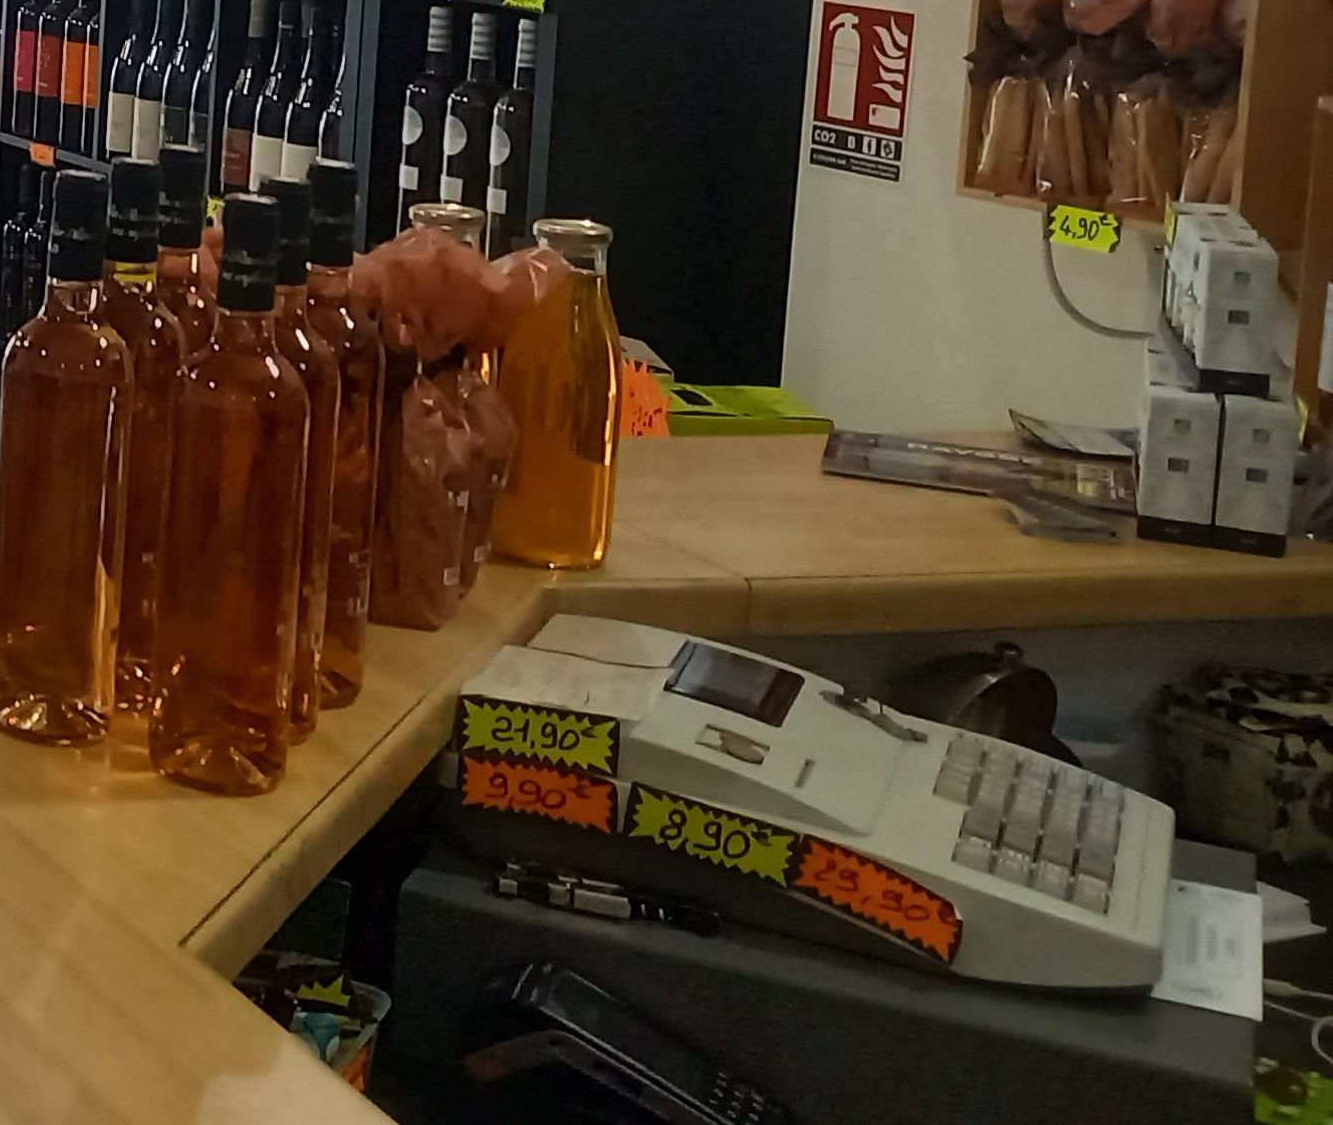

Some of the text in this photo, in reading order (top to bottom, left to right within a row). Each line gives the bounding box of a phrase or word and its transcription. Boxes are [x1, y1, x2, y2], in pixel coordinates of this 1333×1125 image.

[813, 129, 837, 146] CO2
[1059, 212, 1113, 242] 4,90€
[489, 715, 597, 753] 21,90€
[486, 772, 593, 811] 9,90€
[658, 808, 771, 861] 8,90€
